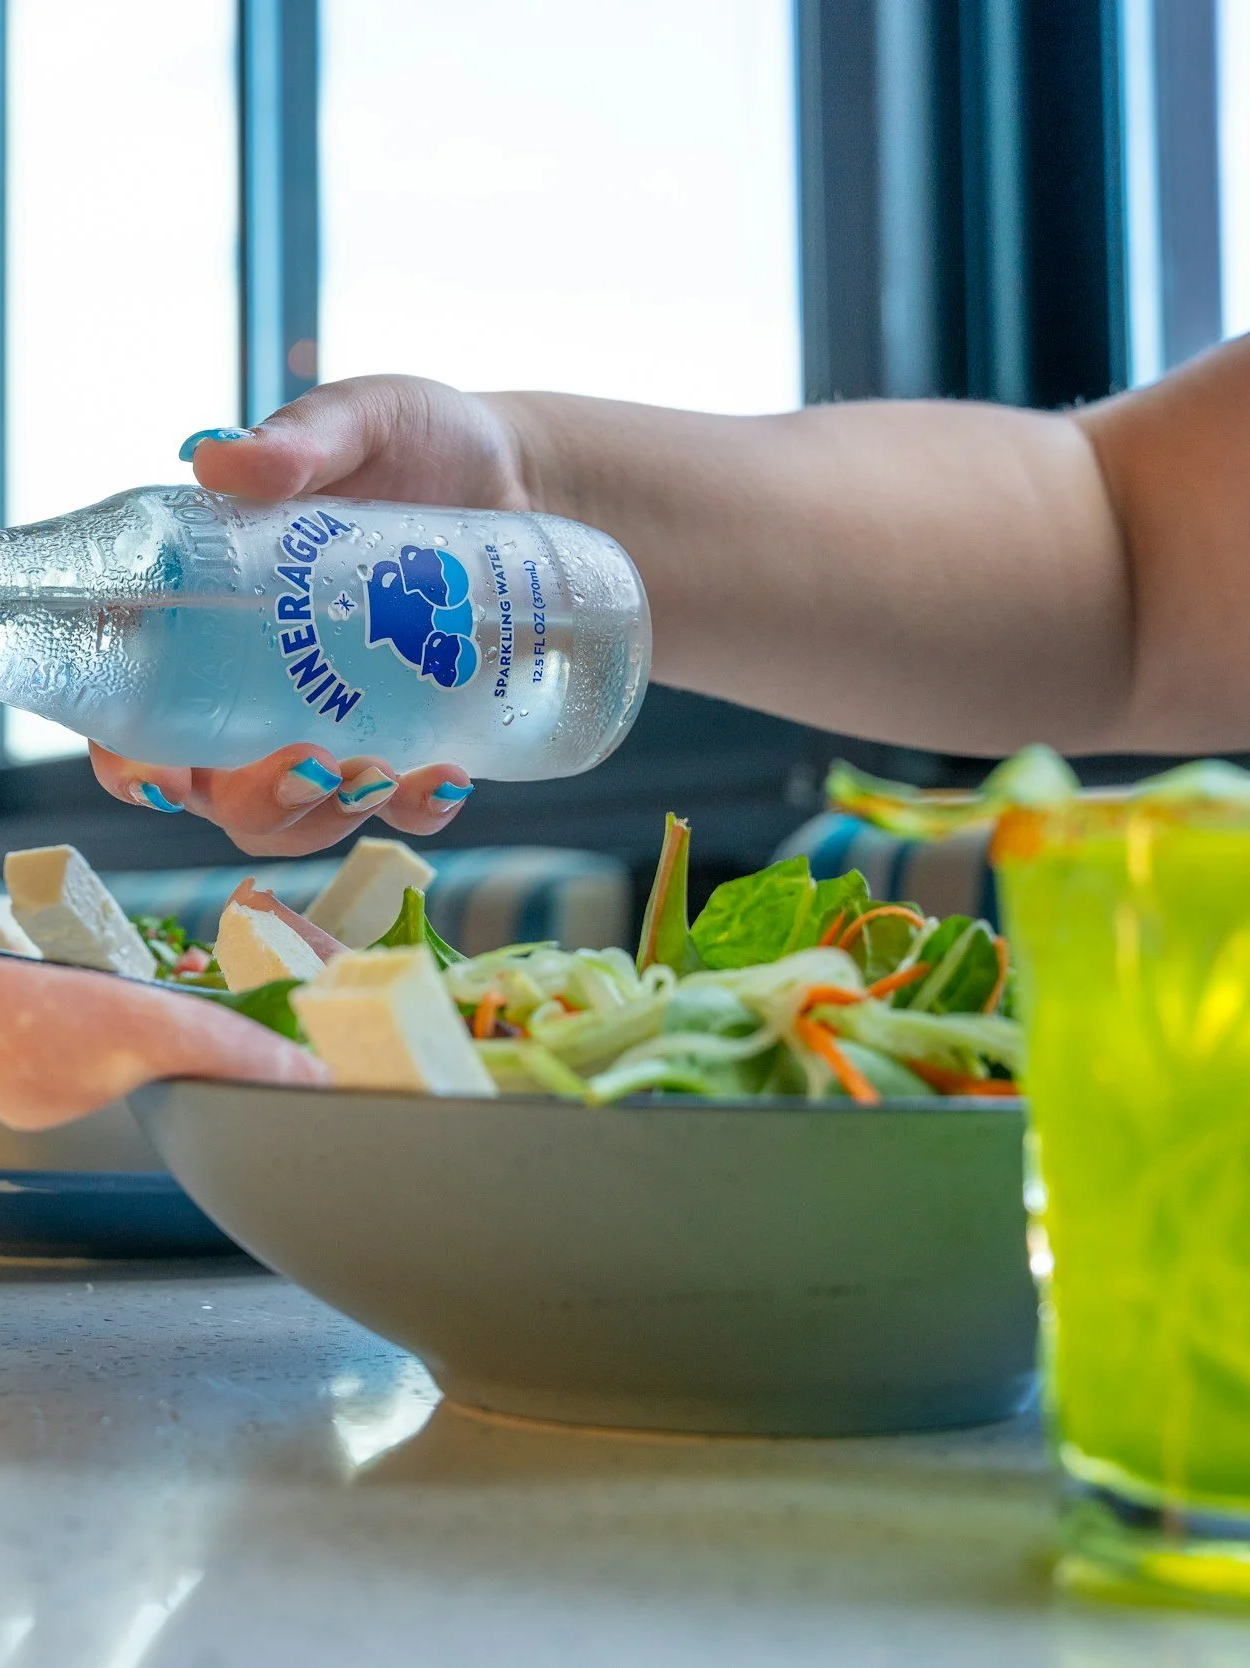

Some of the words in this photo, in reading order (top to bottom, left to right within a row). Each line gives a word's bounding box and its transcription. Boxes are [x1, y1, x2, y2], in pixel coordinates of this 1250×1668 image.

[485, 543, 509, 596] WATER
[523, 559, 547, 611] (370mL)
[278, 510, 361, 723] MINERAGUA
[534, 612, 547, 636] OZ
[494, 600, 513, 698] SPARKLING
[532, 658, 545, 684] 12.5
[534, 637, 547, 656] FL
